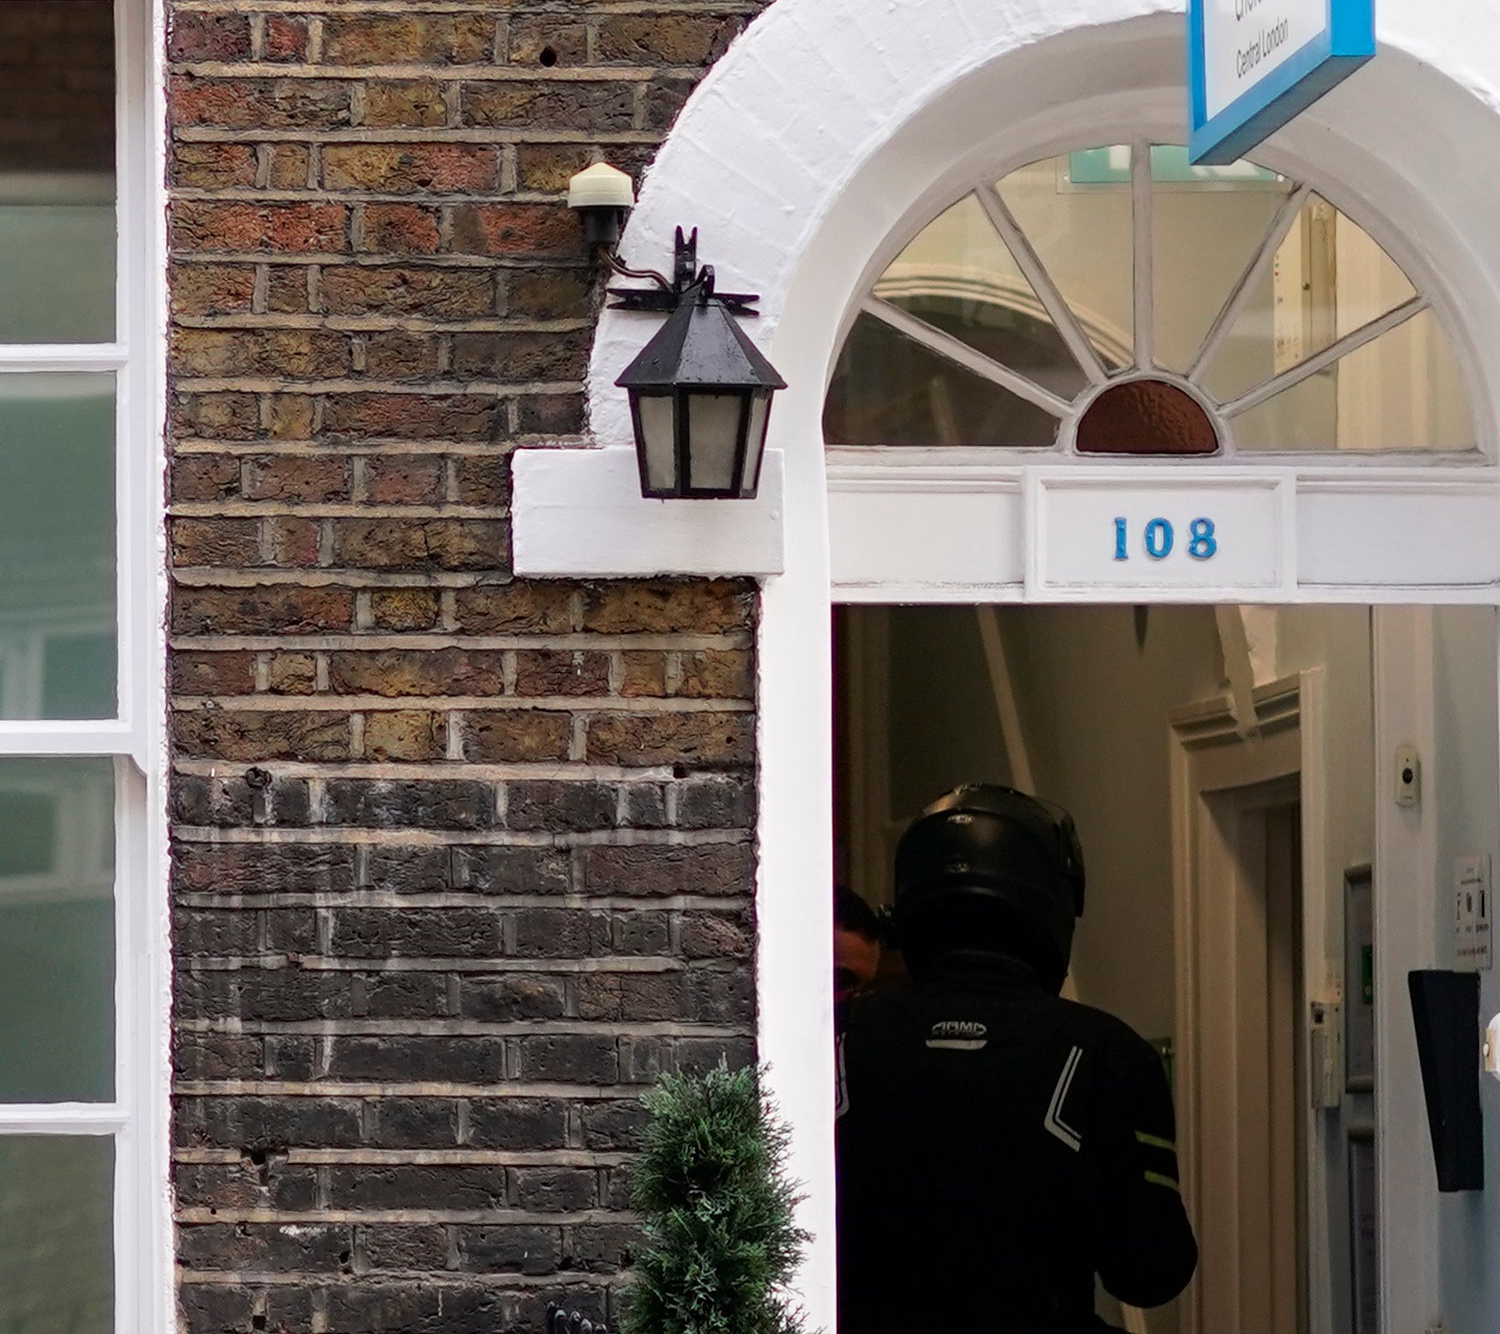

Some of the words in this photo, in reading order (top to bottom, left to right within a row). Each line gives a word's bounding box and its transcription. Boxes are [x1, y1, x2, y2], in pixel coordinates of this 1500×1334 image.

[1236, 29, 1261, 79] Central
[1262, 16, 1289, 57] London
[1114, 517, 1217, 560] 108
